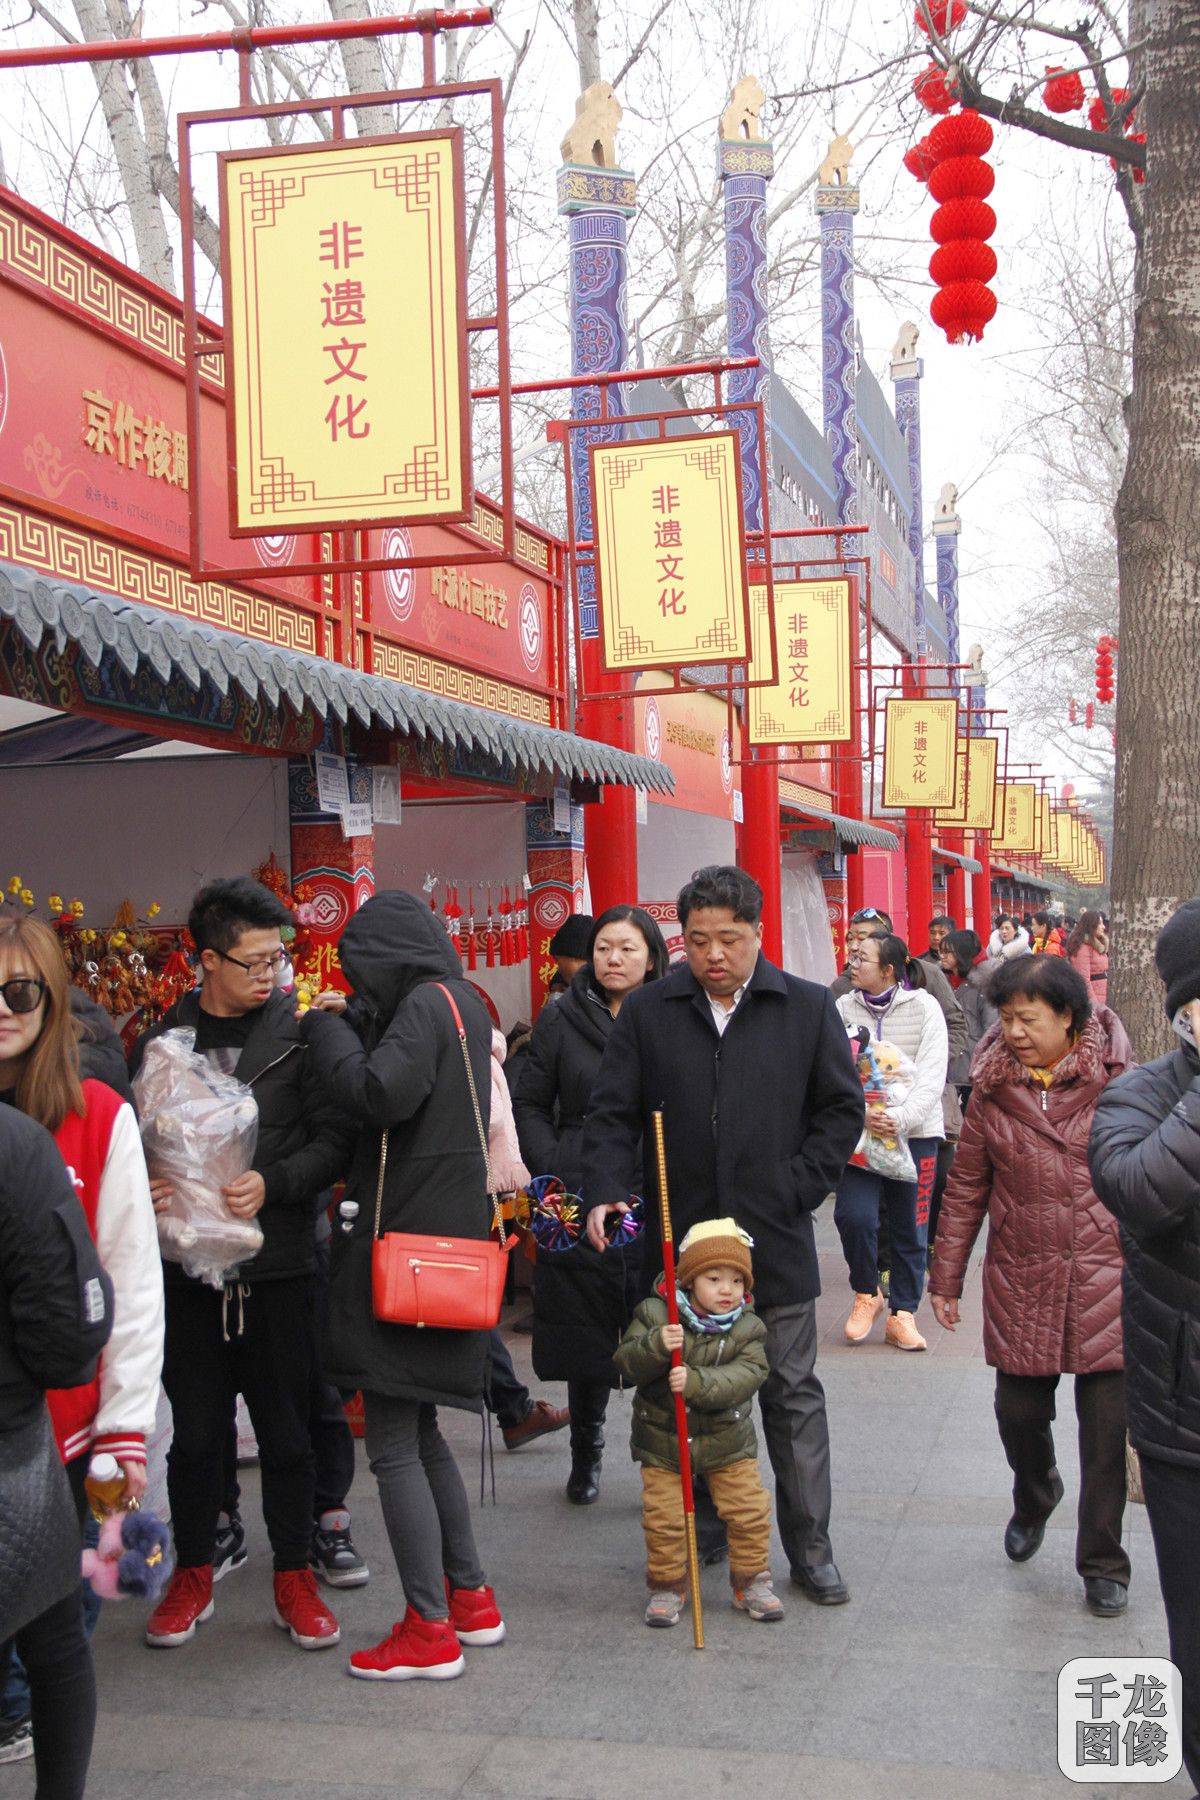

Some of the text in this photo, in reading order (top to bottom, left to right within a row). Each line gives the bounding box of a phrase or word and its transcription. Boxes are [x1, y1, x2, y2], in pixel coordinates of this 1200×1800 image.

[318, 220, 370, 443] 非遗文化
[651, 484, 687, 618] 非遗文化
[787, 612, 810, 708] 非遗文化
[912, 720, 928, 784] 非遗文化
[916, 1155, 937, 1227] BOXER
